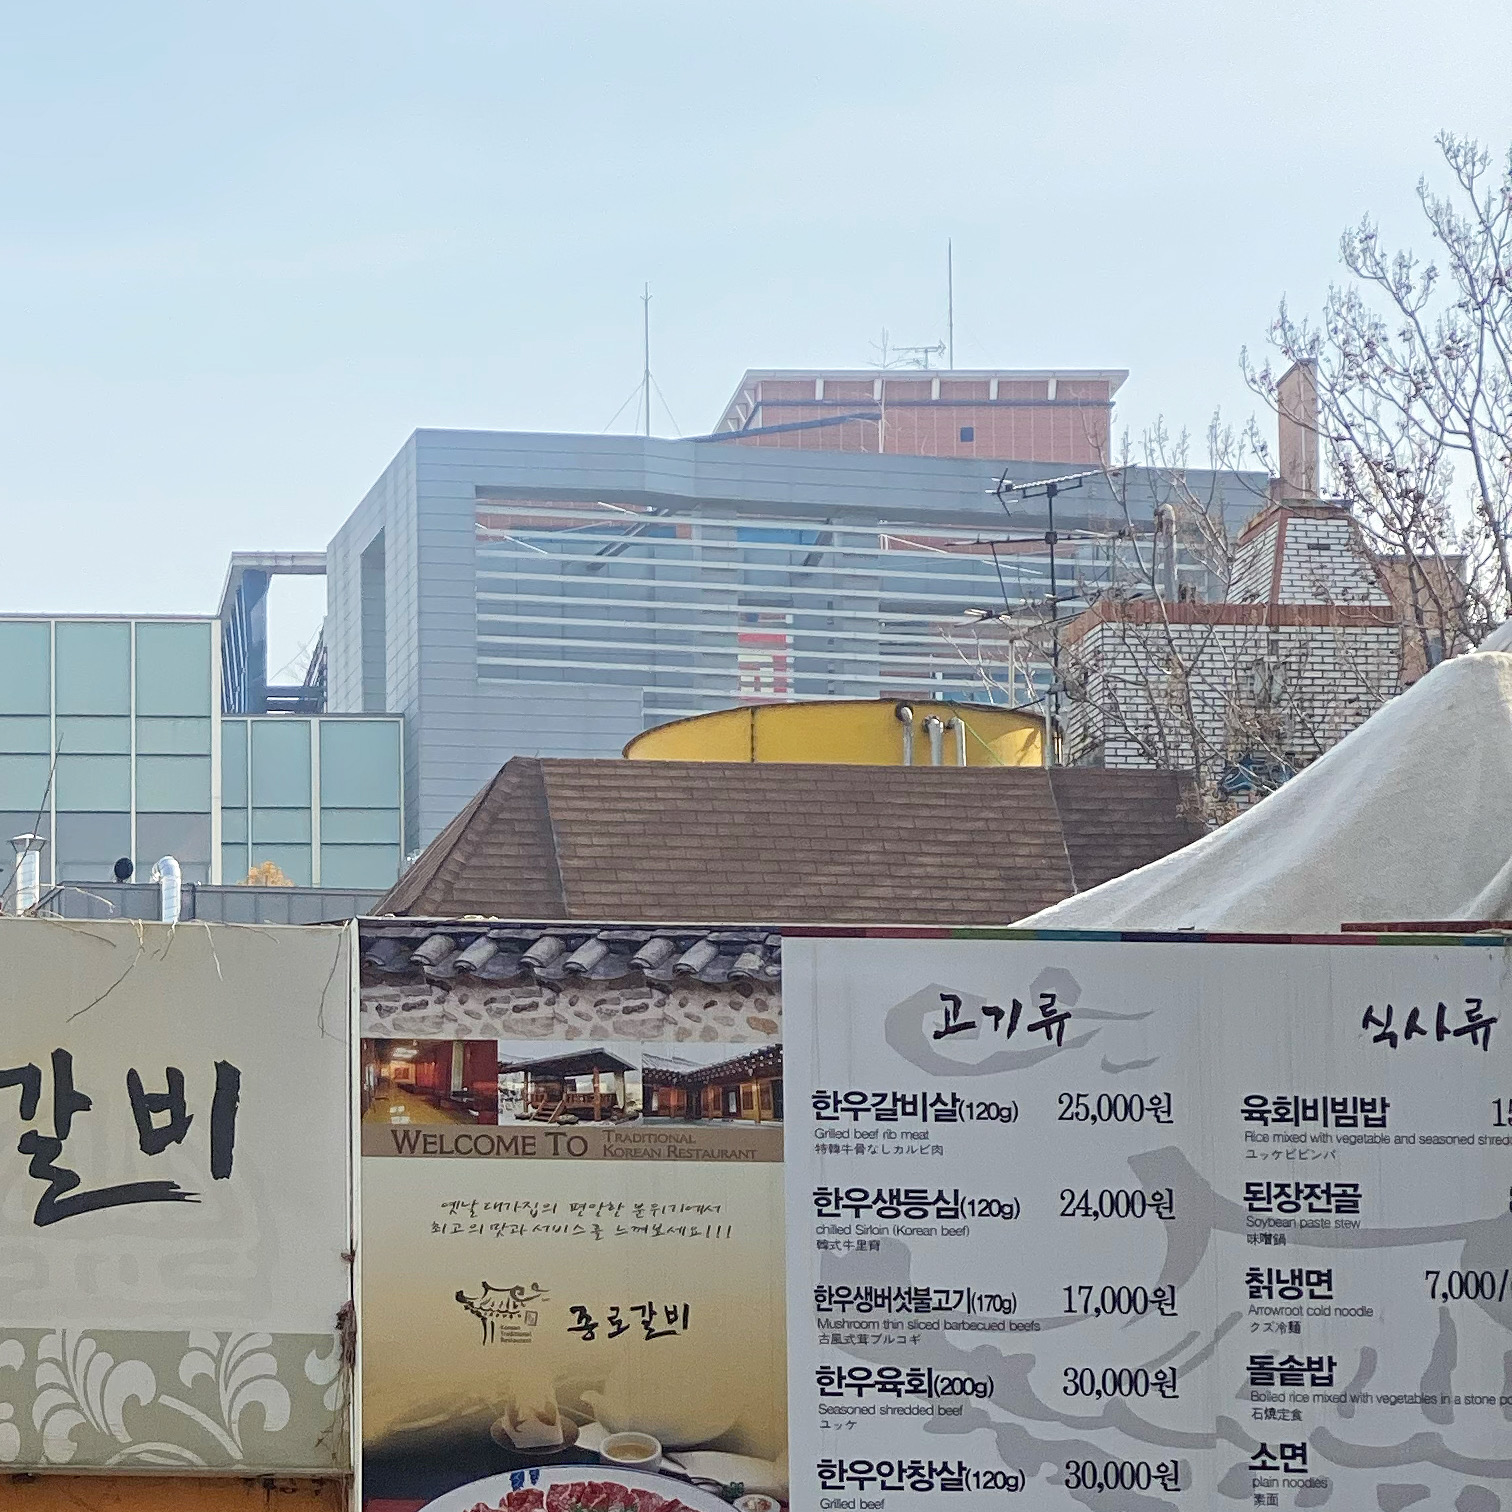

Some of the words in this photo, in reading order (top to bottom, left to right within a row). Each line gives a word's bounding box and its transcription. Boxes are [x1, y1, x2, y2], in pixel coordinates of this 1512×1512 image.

[933, 993, 1072, 1047] 고기류
[1362, 998, 1498, 1052] 식사류
[811, 1090, 1019, 1123] 한우갈비살(120g)
[1058, 1092, 1174, 1125] 25,000원
[1240, 1094, 1391, 1128] 육회비빔밥
[391, 1129, 536, 1157] WELCOME
[814, 1128, 850, 1140] Grilled
[853, 1128, 879, 1140] beef
[882, 1129, 897, 1140] rib
[900, 1130, 929, 1140] meat
[1244, 1131, 1270, 1143] Rice
[1273, 1131, 1307, 1143] mixed
[1310, 1132, 1333, 1144] with
[1394, 1133, 1415, 1145] and
[1419, 1133, 1475, 1145] seasoned
[812, 1187, 1021, 1220] 한우생등심(120g)
[1060, 1188, 1175, 1221] 24,000원
[1243, 1181, 1363, 1214] 된장전골
[816, 1224, 851, 1236] chilled
[855, 1225, 889, 1236] Sirloin
[893, 1225, 937, 1237] (Korean
[941, 1225, 970, 1237] beef)
[1246, 1216, 1296, 1230] Soybean
[1300, 1217, 1331, 1230] paste
[1335, 1217, 1361, 1229] stew
[814, 1285, 1017, 1315] 한우생버섯불고기(170g)
[1245, 1267, 1333, 1300] 칡냉면
[1063, 1284, 1178, 1318] 17,000원
[1248, 1304, 1304, 1316] Arrowroot
[1307, 1305, 1332, 1317] cold
[1335, 1306, 1374, 1317] noodle
[567, 1301, 690, 1341] 종로갈비
[817, 1318, 879, 1330] Mushroom
[882, 1318, 904, 1330] thin
[907, 1319, 939, 1331] sliced
[944, 1319, 1005, 1332] barbecued
[1010, 1320, 1041, 1332] beefs
[815, 1366, 994, 1399] 한우육회(200g)
[1063, 1366, 1179, 1400] 30,000원
[1246, 1354, 1338, 1387] 돌솥밥
[818, 1403, 876, 1415] Seasoned
[880, 1404, 934, 1416] shredded
[938, 1404, 964, 1416] beef
[1289, 1391, 1310, 1403] rice
[1313, 1391, 1348, 1404] mixed
[1350, 1392, 1373, 1404] with
[1376, 1392, 1438, 1406] vegetables
[1440, 1393, 1451, 1404] in
[1454, 1396, 1461, 1405] a
[1464, 1394, 1496, 1405] stone
[1248, 1442, 1308, 1474] 소면
[816, 1459, 1026, 1492] 한우안창살(120g)
[1065, 1459, 1181, 1493] 30,000원
[1252, 1476, 1279, 1489] plain
[1282, 1477, 1328, 1489] noodles
[820, 1498, 856, 1510] Grilled
[860, 1498, 885, 1510] beef
